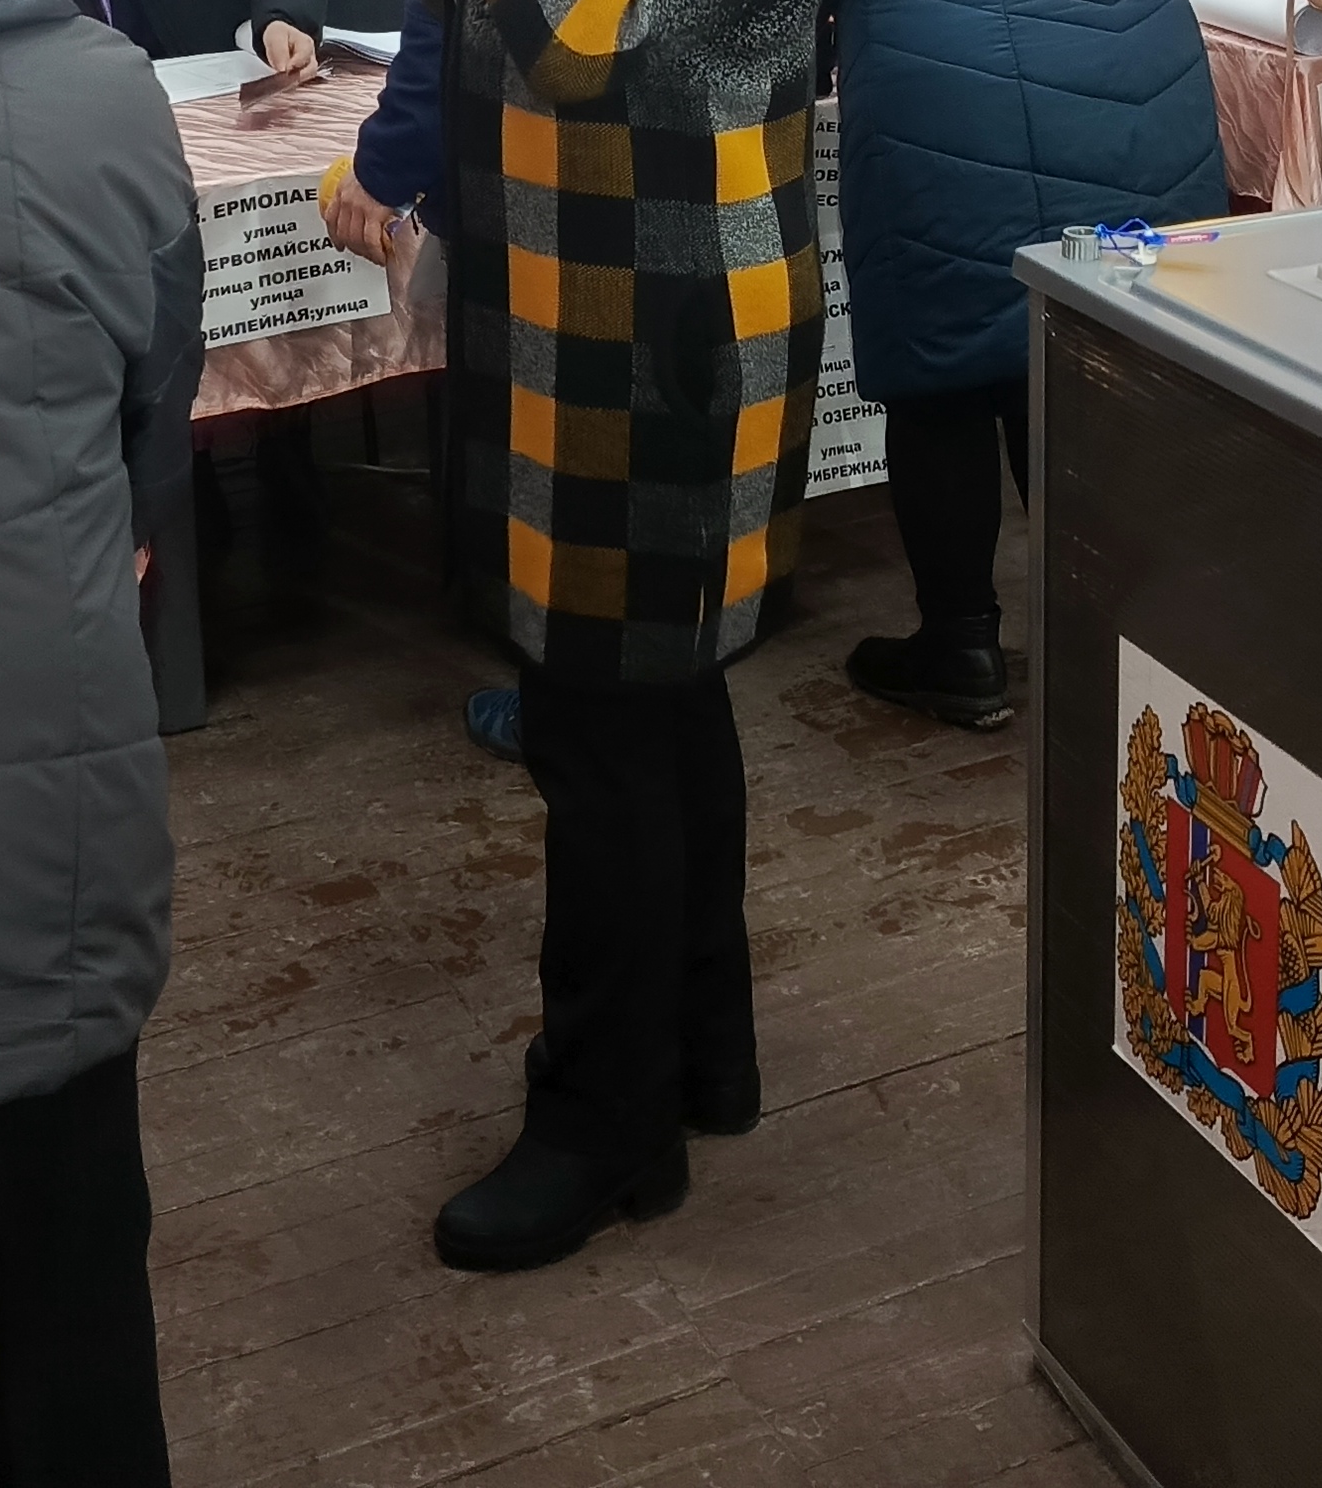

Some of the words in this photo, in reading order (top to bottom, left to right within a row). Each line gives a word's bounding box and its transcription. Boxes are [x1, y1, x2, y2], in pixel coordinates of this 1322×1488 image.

[213, 188, 318, 220] ЕРМОЛАЕ
[243, 221, 298, 243] улица
[204, 236, 335, 274] ЕРВОМАЙСКА
[258, 259, 352, 288] ПОЛЕВАЯ;
[249, 288, 305, 311] улица
[822, 403, 885, 425] ОЗЕРНА
[820, 442, 862, 461] улица
[806, 458, 888, 485] РИБРЕЖНАЯ
